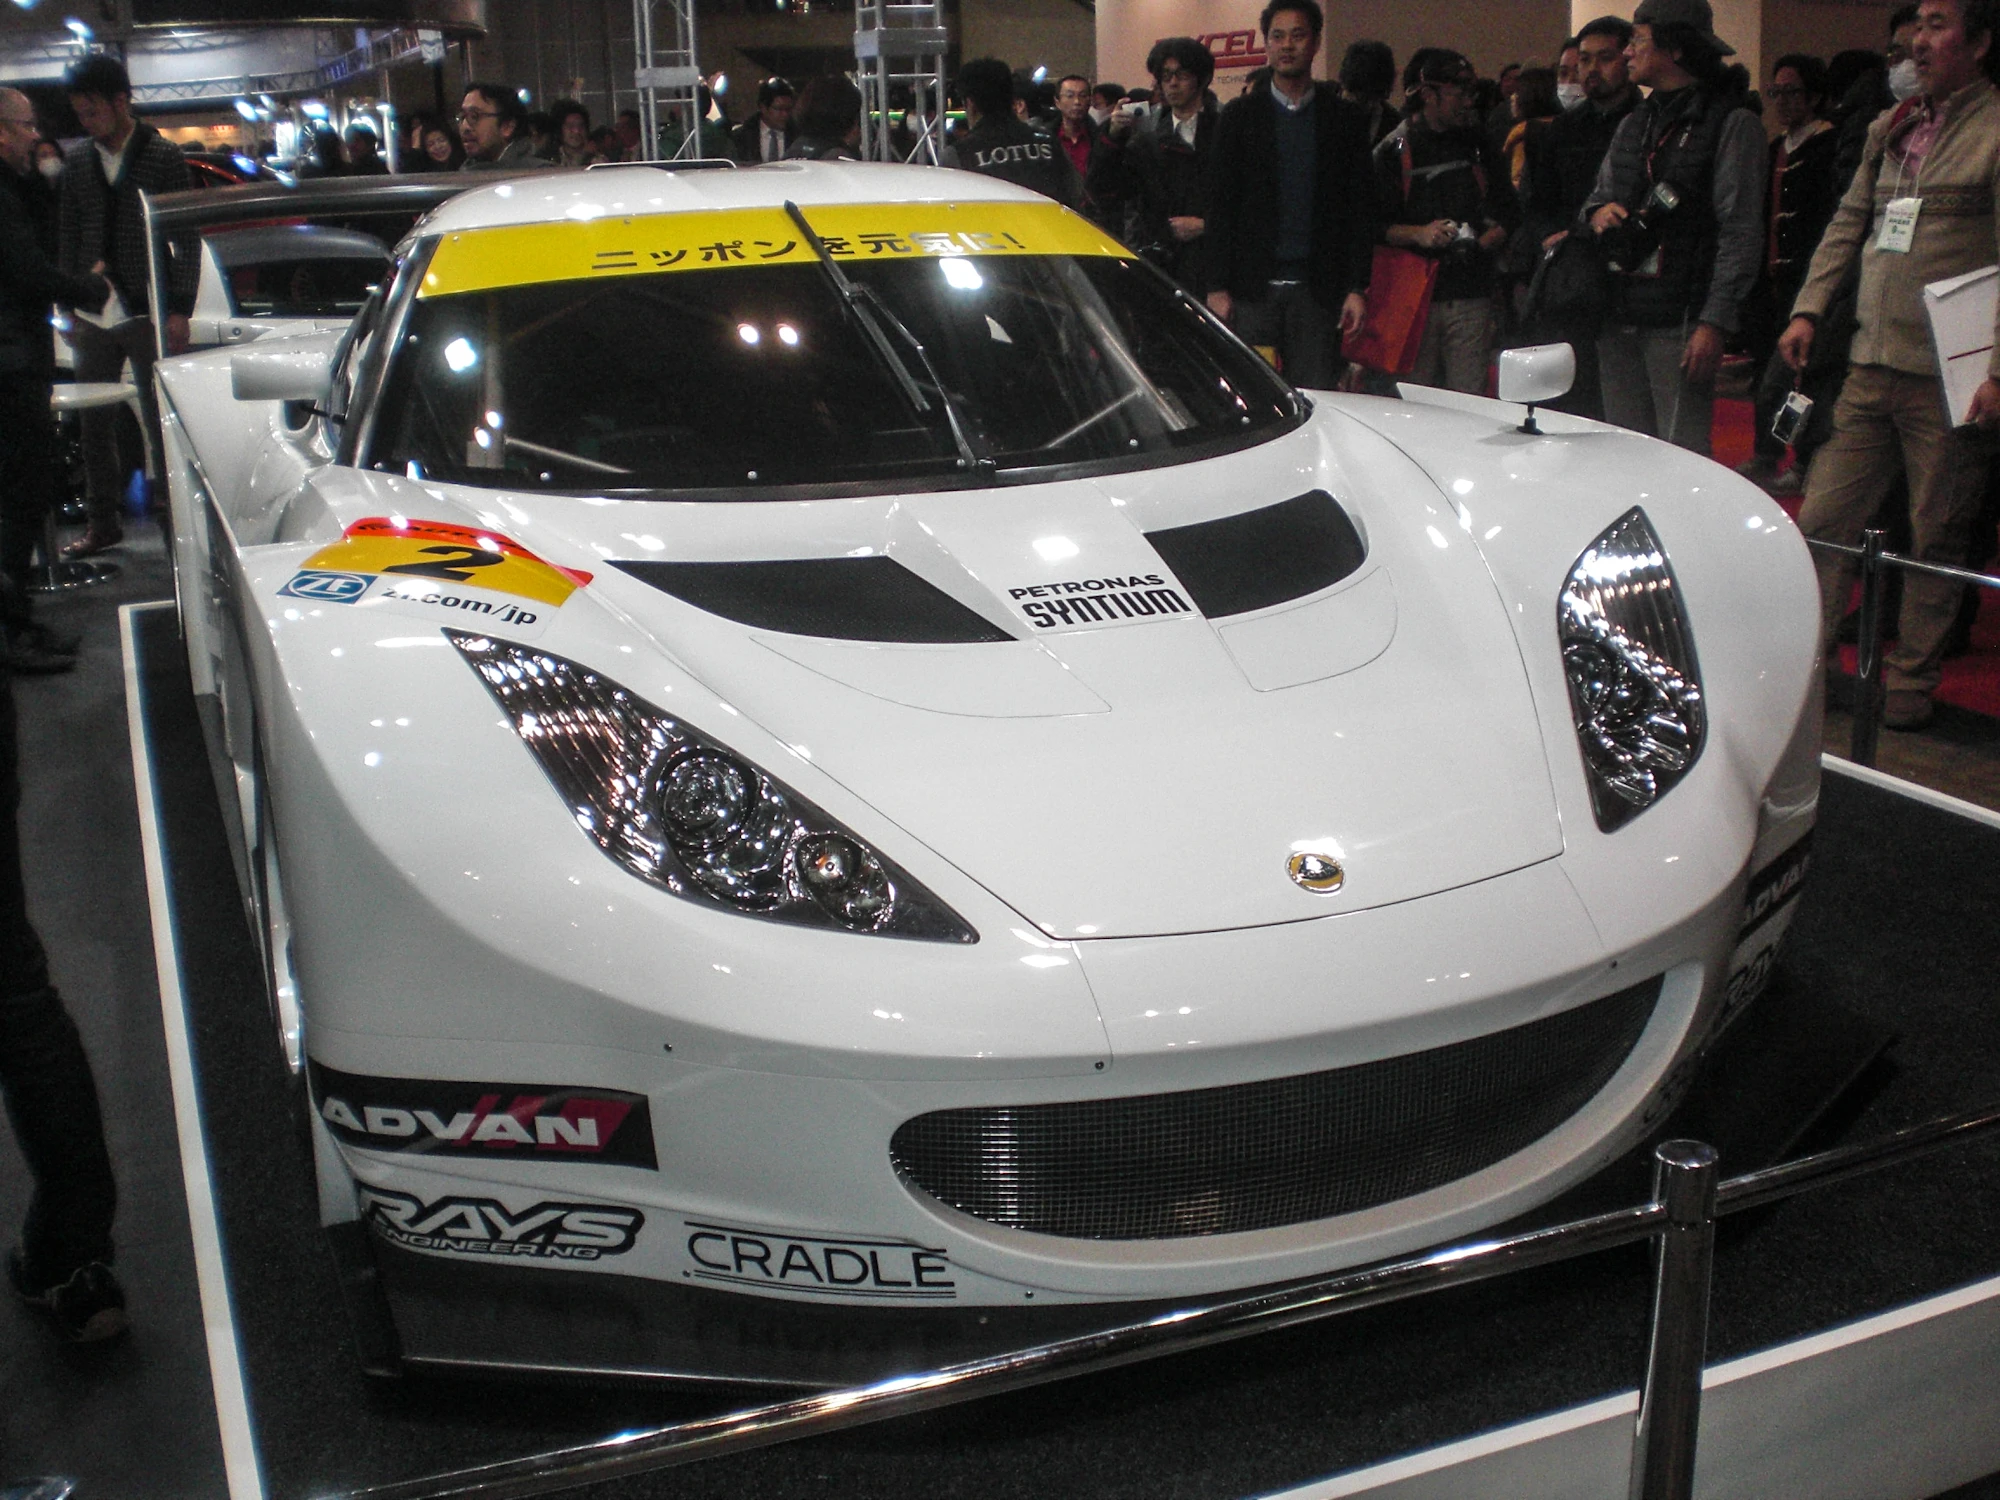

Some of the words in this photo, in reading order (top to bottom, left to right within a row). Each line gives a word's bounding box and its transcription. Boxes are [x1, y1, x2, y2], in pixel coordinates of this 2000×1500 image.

[975, 143, 1052, 167] LOTUS
[381, 545, 505, 581] 2
[296, 577, 364, 597] ZF
[1008, 574, 1165, 600] PETRONAS
[1022, 588, 1192, 628] SYNTIUM
[322, 1096, 599, 1147] ADVAN
[359, 1186, 639, 1250] RAYS
[687, 1231, 955, 1288] CRADLE
